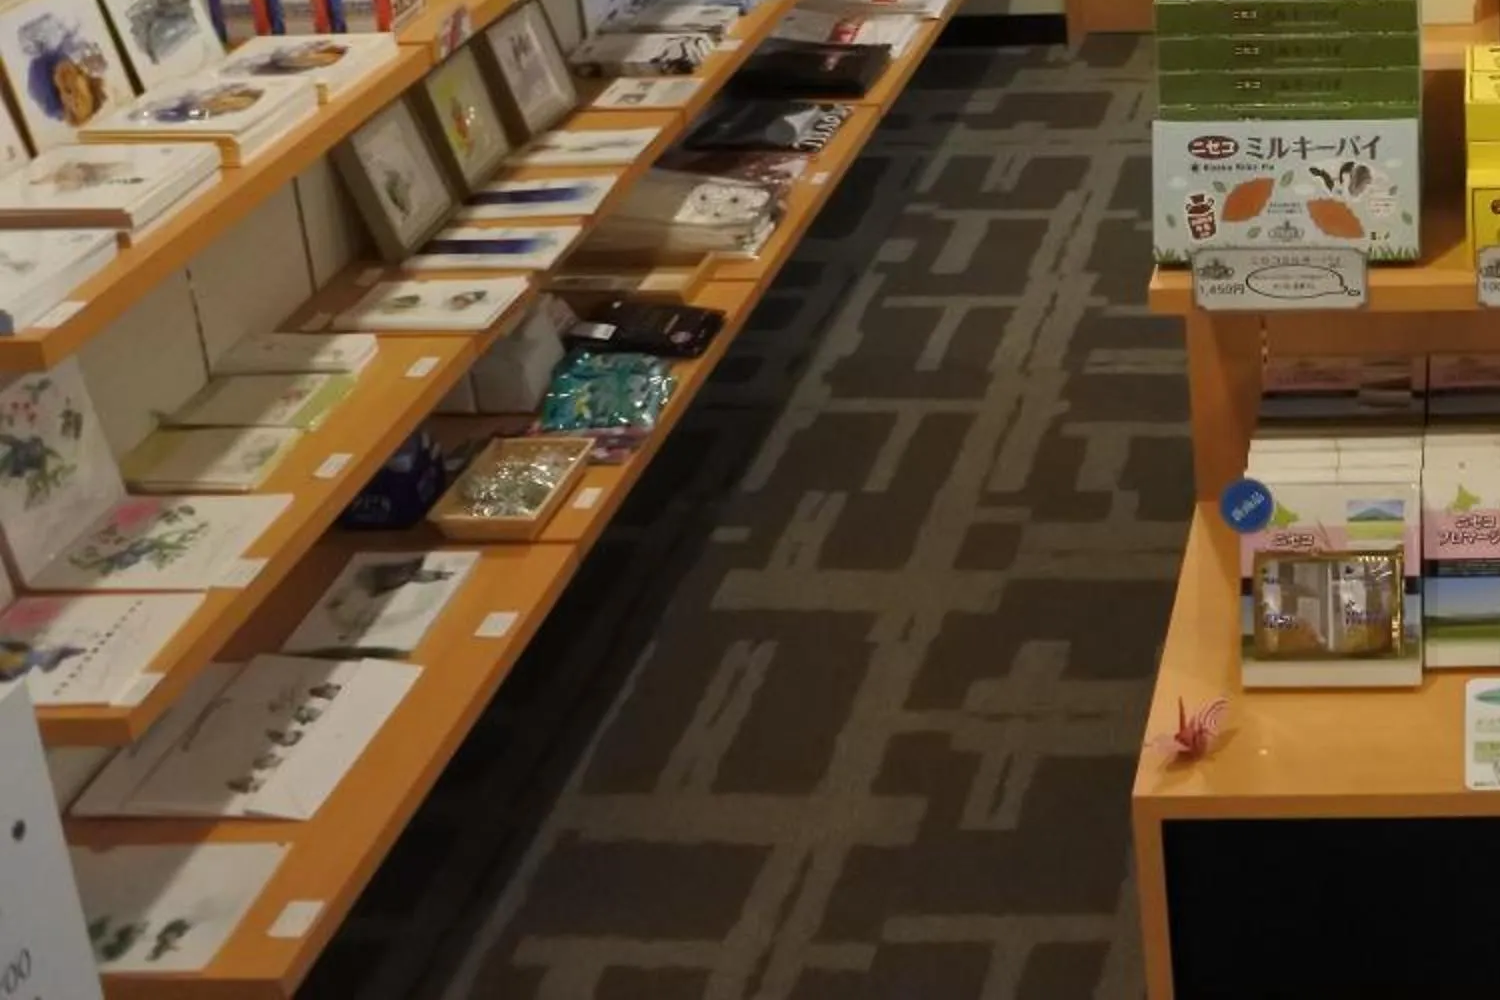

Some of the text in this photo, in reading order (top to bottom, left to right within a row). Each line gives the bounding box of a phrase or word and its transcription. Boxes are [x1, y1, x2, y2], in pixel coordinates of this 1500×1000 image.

[1191, 140, 1236, 156] ニセコ
[1454, 514, 1498, 530] ニセコ
